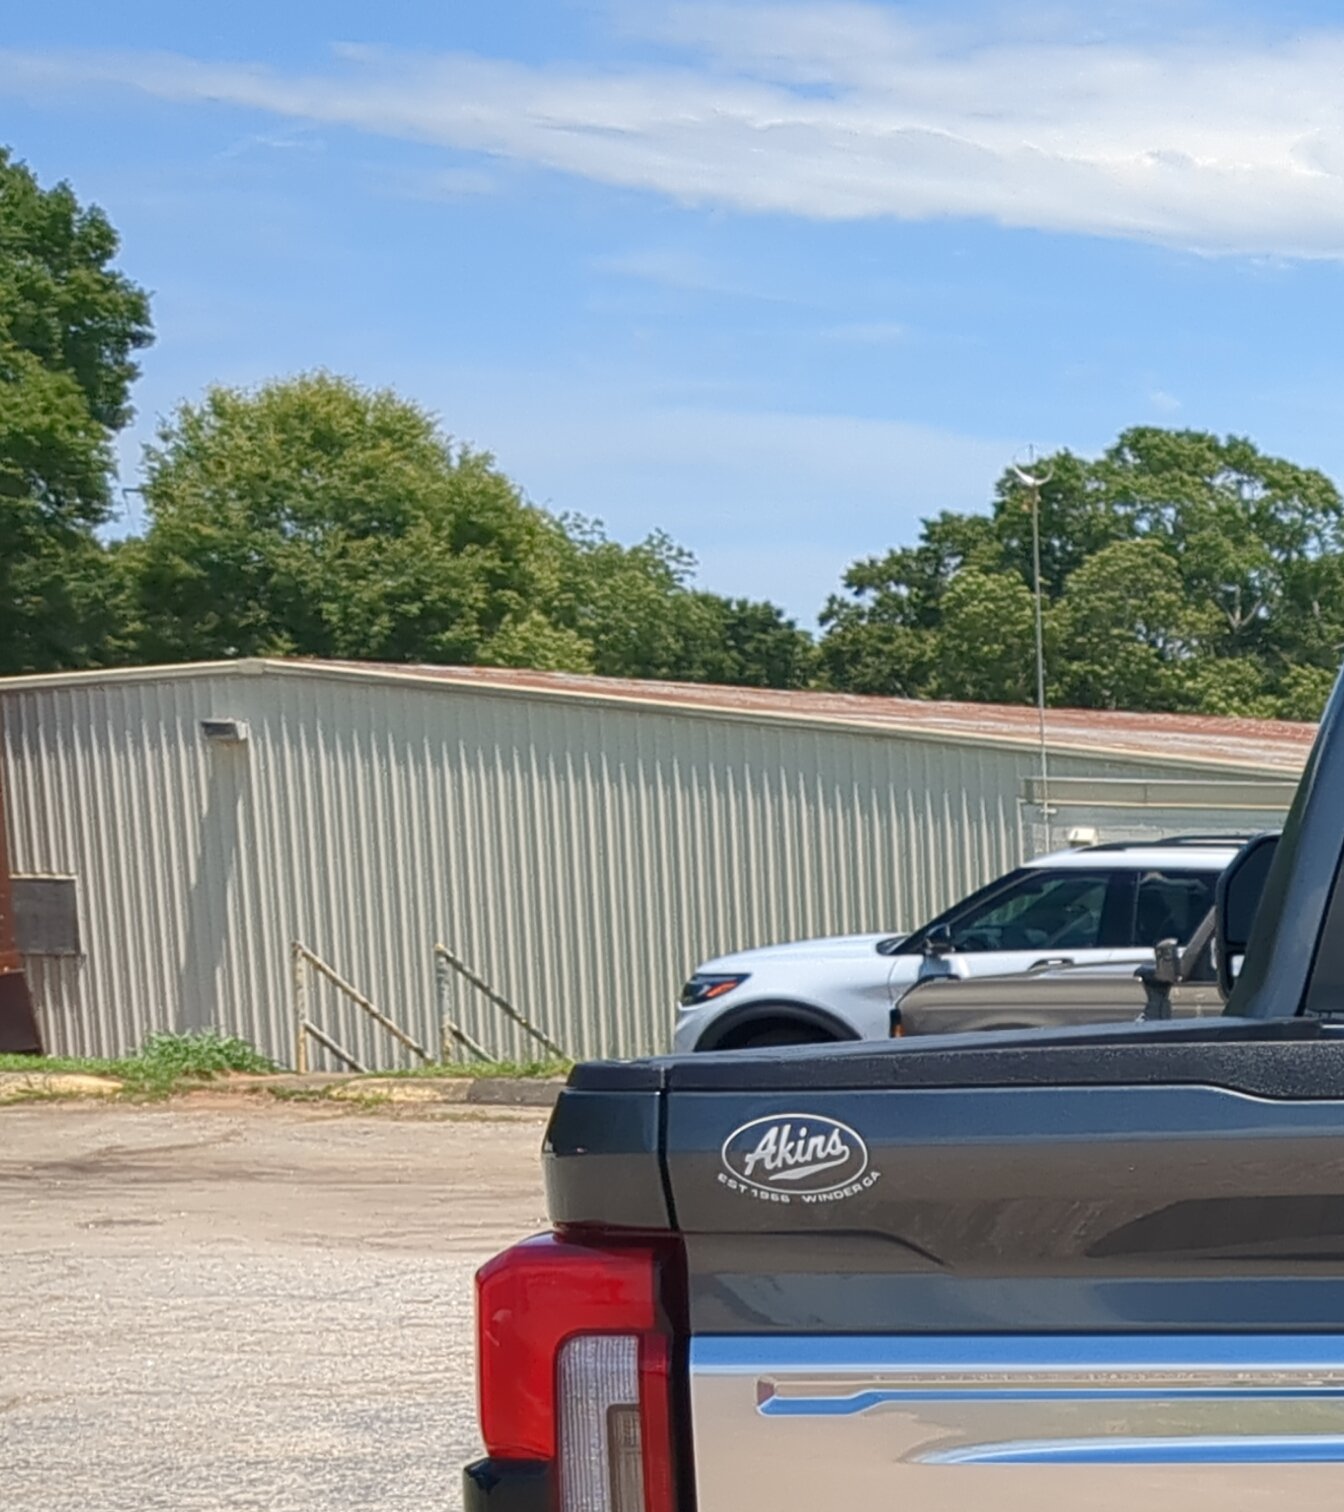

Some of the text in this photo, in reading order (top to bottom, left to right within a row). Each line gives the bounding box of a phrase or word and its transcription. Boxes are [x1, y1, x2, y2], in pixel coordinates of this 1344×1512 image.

[744, 1124, 850, 1178] Akins
[717, 1172, 748, 1194] EST
[801, 1182, 863, 1203] WINDER
[862, 1170, 881, 1187] GA
